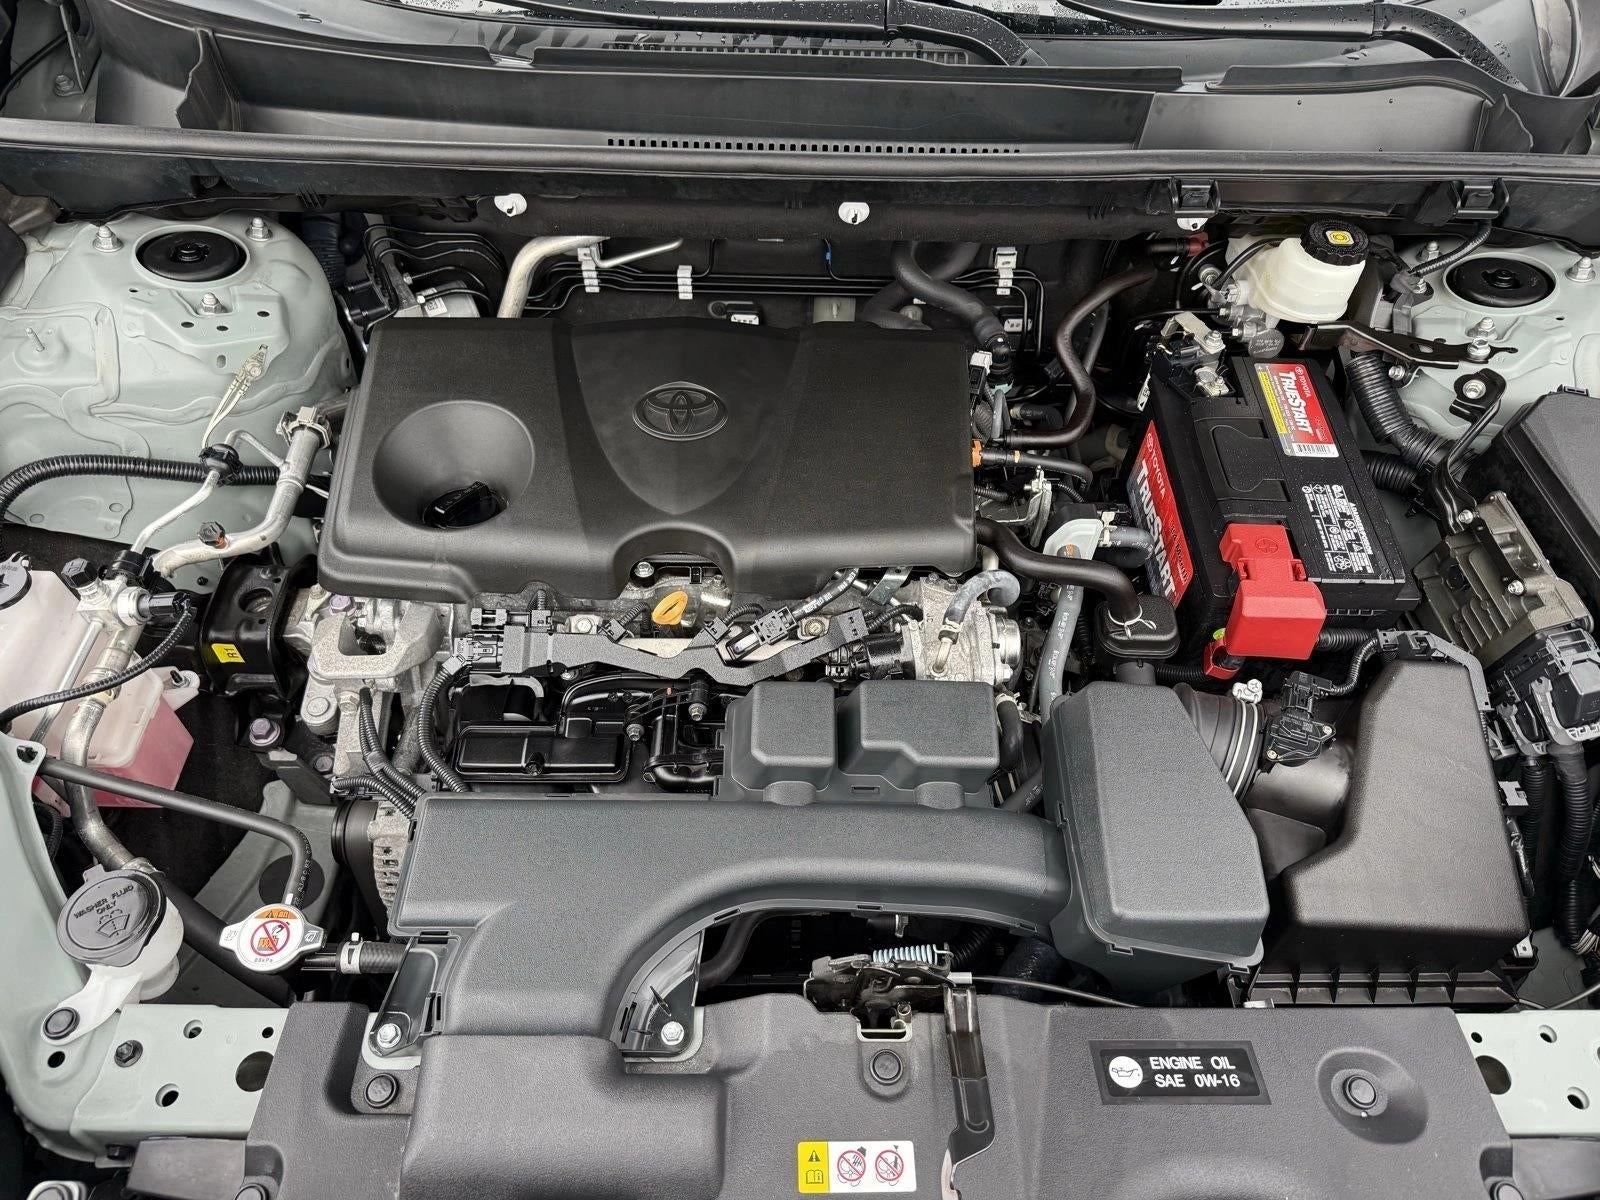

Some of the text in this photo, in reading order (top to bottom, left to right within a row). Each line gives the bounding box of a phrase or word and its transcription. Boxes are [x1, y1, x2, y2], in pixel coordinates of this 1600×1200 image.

[1299, 375, 1312, 398] TOYOTA
[1150, 453, 1167, 499] TOYOTA
[73, 884, 134, 919] WASHER FLUID
[96, 900, 117, 915] ONLY
[1149, 1056, 1236, 1070] ENGINE OIL
[1154, 1073, 1241, 1088] SAE 0W-16
